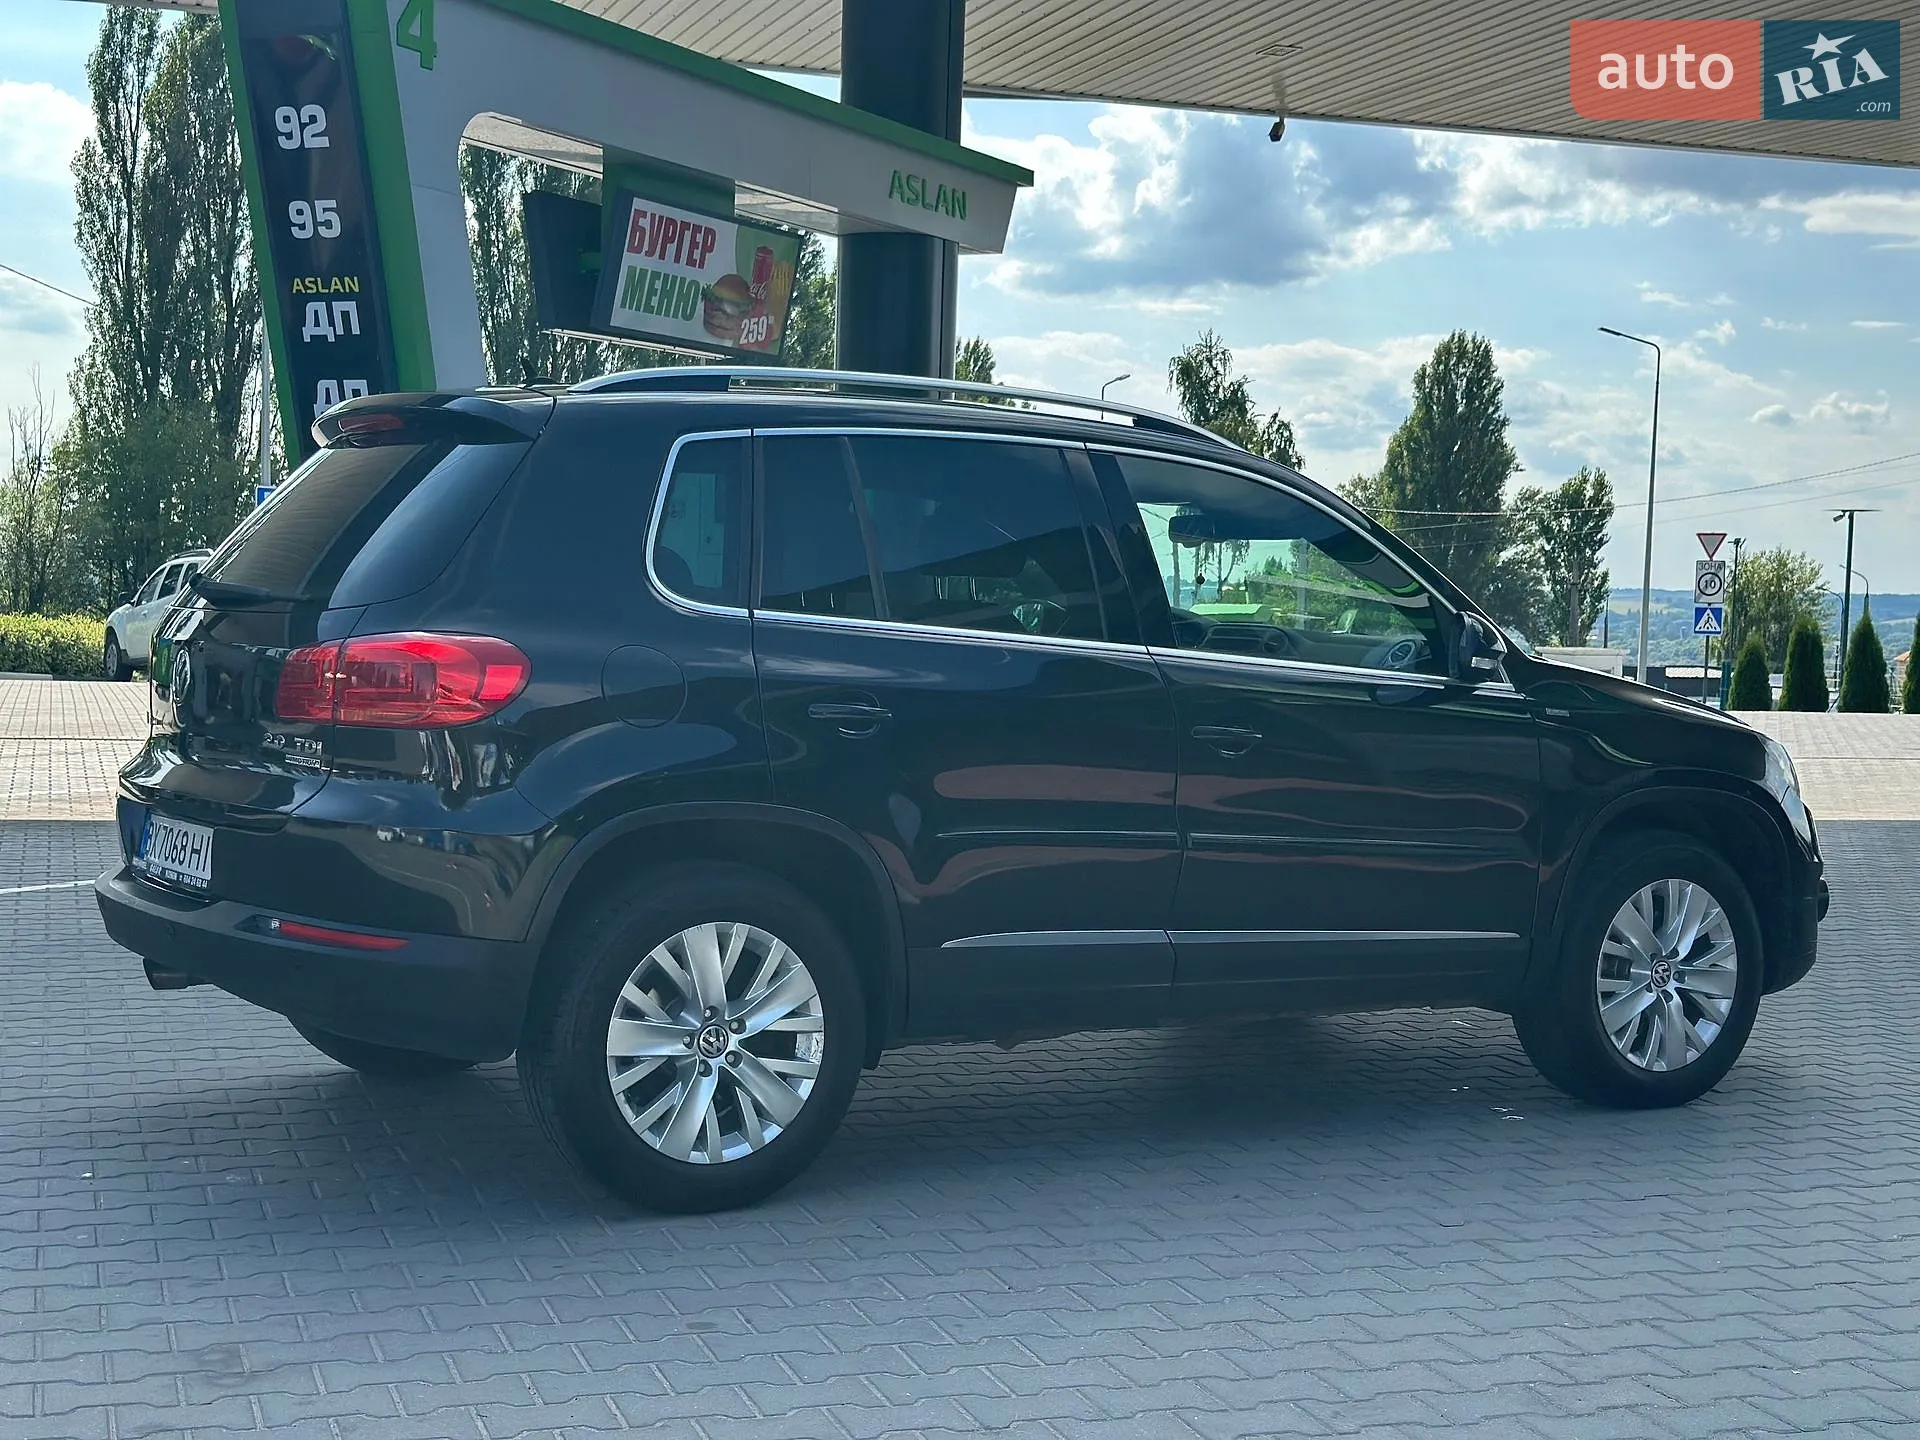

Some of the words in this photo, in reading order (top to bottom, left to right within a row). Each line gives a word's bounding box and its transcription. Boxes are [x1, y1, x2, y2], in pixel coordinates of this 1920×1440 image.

[396, 0, 437, 70] 4
[274, 104, 330, 149] 92
[889, 169, 967, 220] ASLAN
[288, 200, 342, 239] 95
[627, 208, 716, 269] БУРГЕР
[292, 277, 360, 293] ASLAN
[620, 265, 700, 321] МЕНЮ
[302, 301, 361, 343] ДП
[739, 316, 767, 344] 259
[1699, 562, 1722, 571] ЗОНА
[1703, 580, 1716, 590] 10
